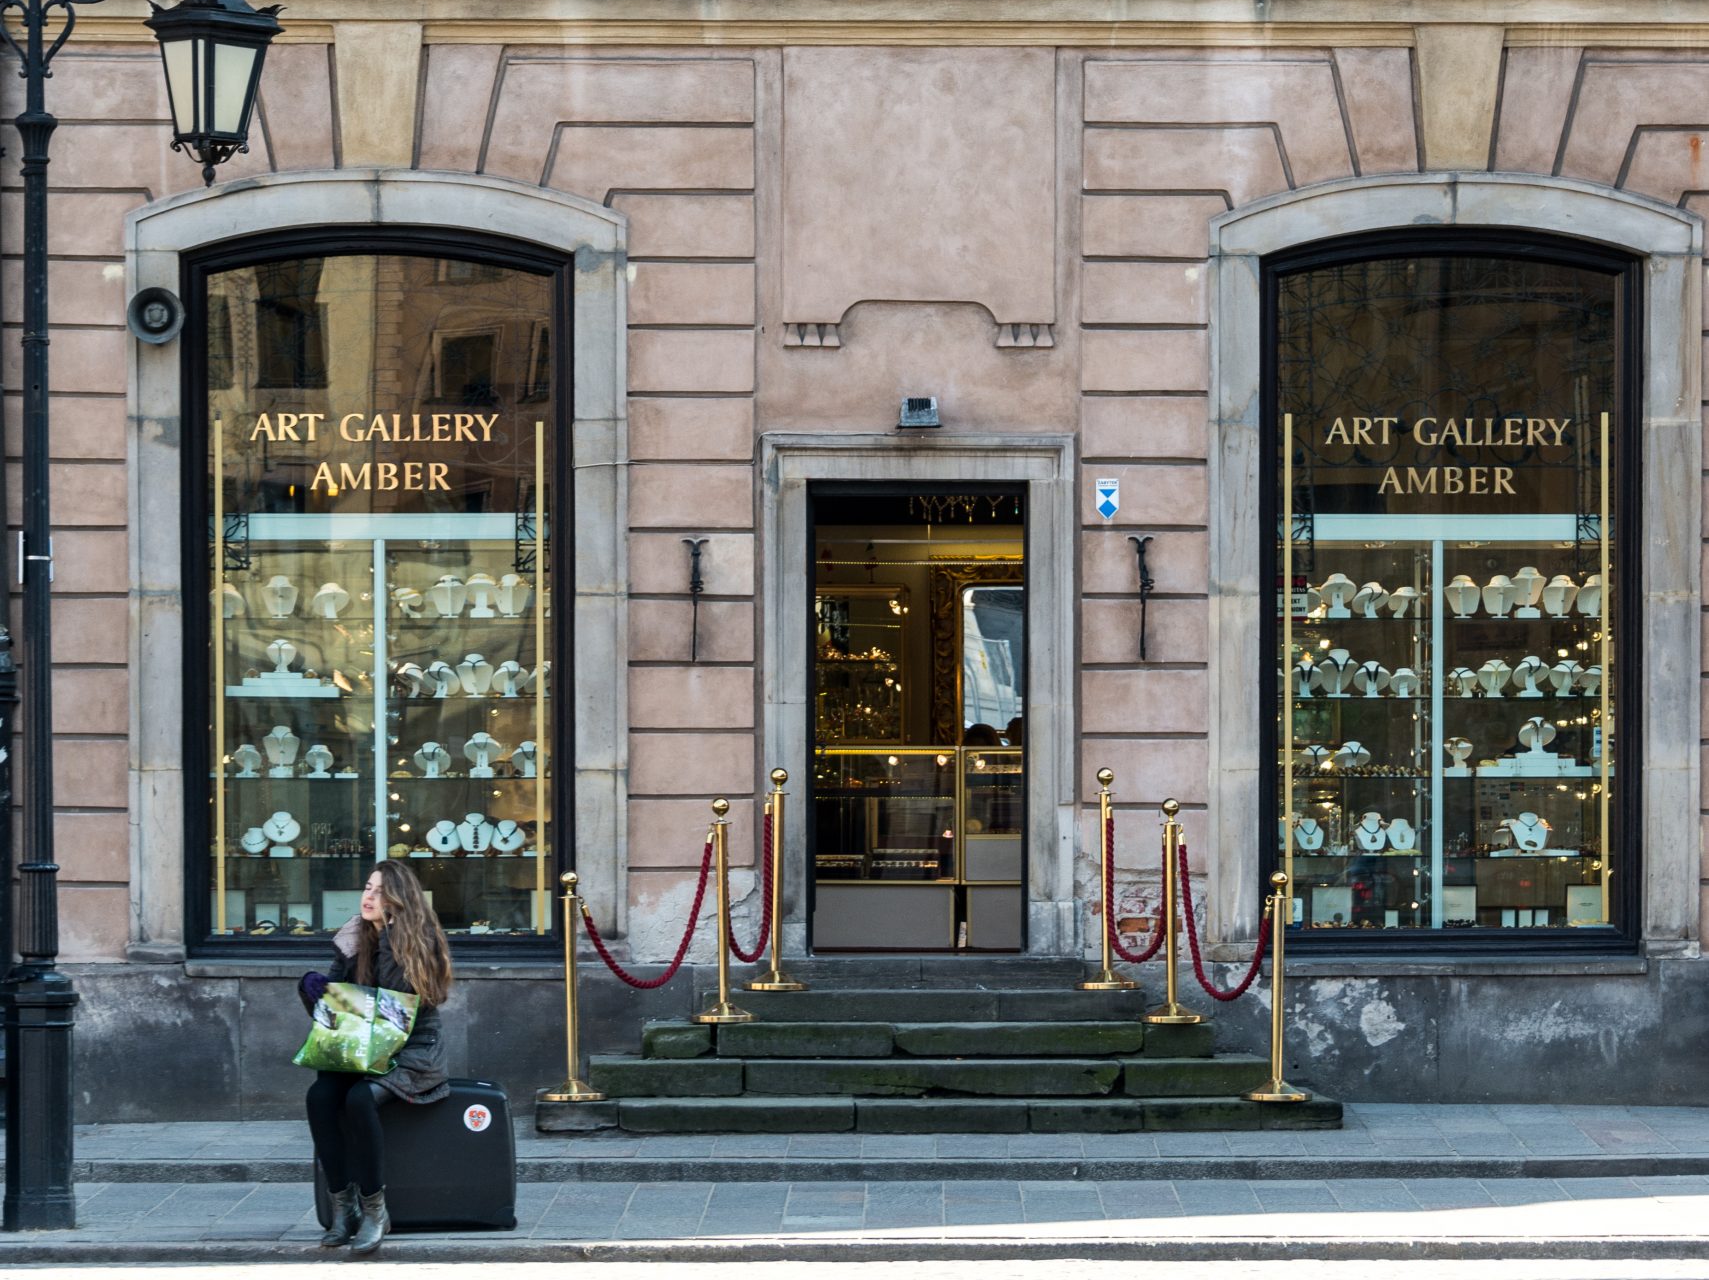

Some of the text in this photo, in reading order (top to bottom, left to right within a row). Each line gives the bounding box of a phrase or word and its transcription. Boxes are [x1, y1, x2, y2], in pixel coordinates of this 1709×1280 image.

[249, 413, 500, 442] ART GALLERY
[1325, 417, 1571, 446] ART GALLERY
[310, 462, 452, 491] AMBER
[1378, 466, 1516, 494] AMBER
